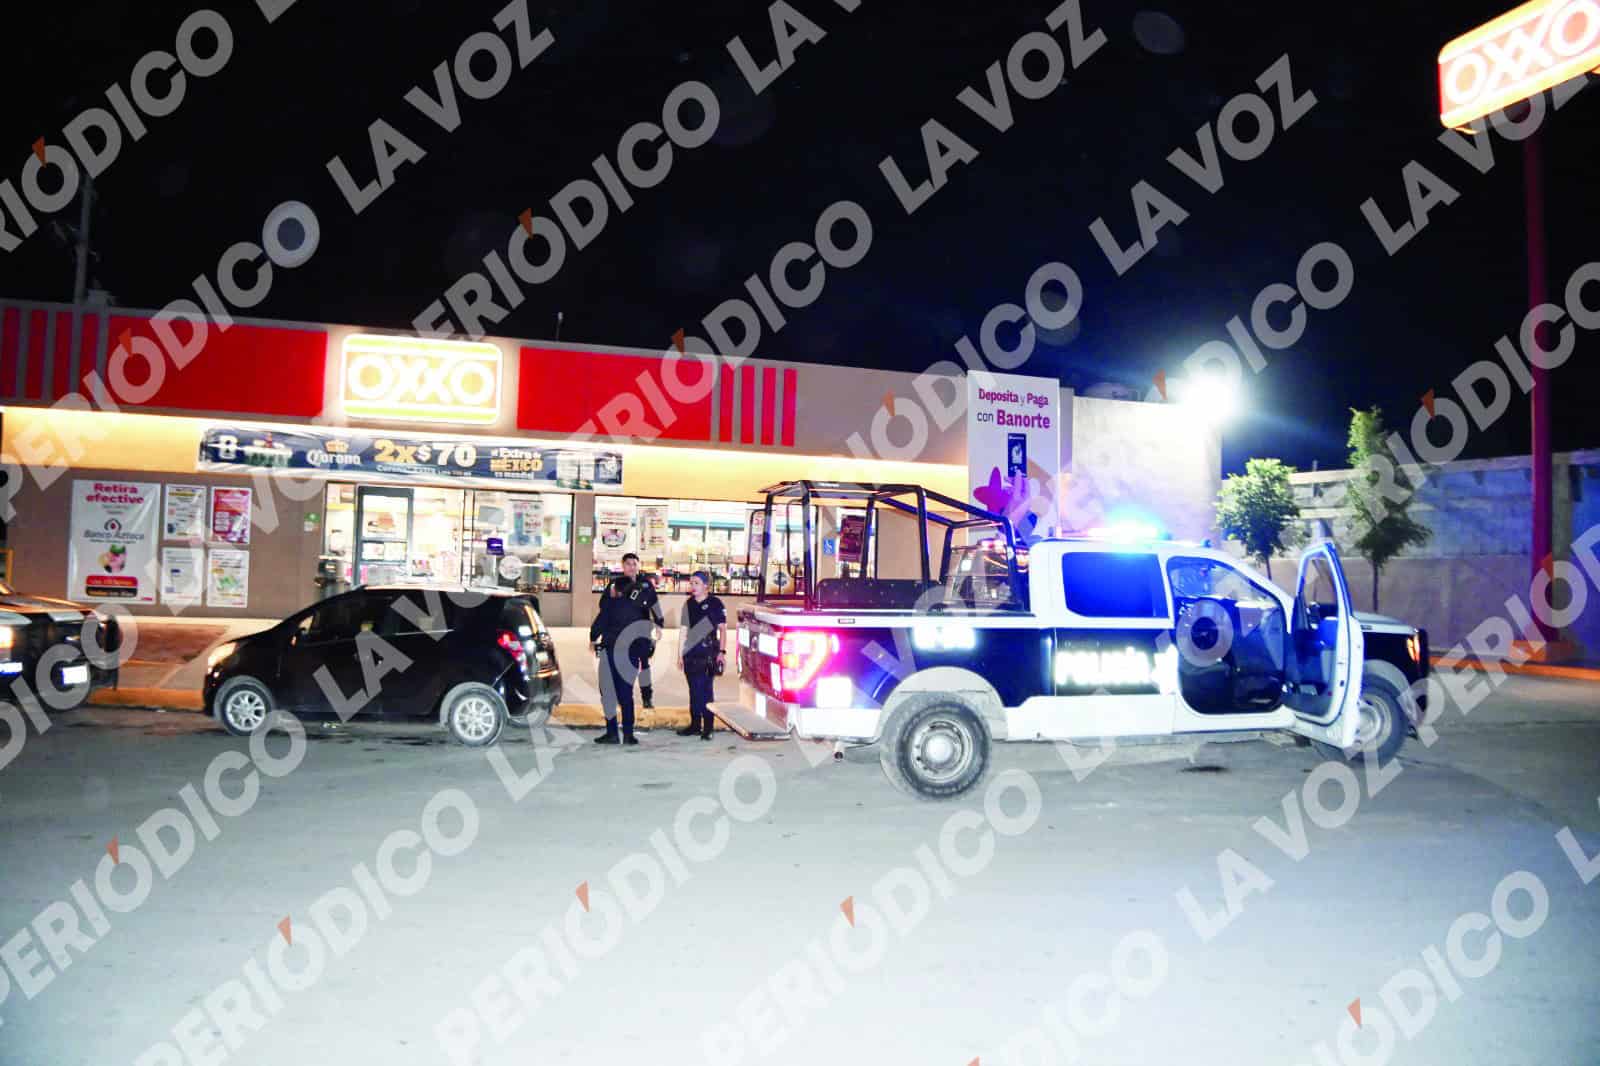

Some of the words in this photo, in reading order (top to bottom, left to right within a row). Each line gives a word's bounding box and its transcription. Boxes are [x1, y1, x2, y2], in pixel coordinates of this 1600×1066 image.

[1443, 0, 1600, 106] OXXO
[348, 354, 496, 405] OXXO
[978, 388, 1019, 404] Deposita
[1020, 396, 1025, 406] y
[1027, 393, 1049, 408] Paga
[977, 411, 994, 422] con
[997, 409, 1051, 429] Banorte
[306, 449, 361, 466] Corona
[93, 483, 138, 494] Retira
[85, 494, 144, 504] efectivo
